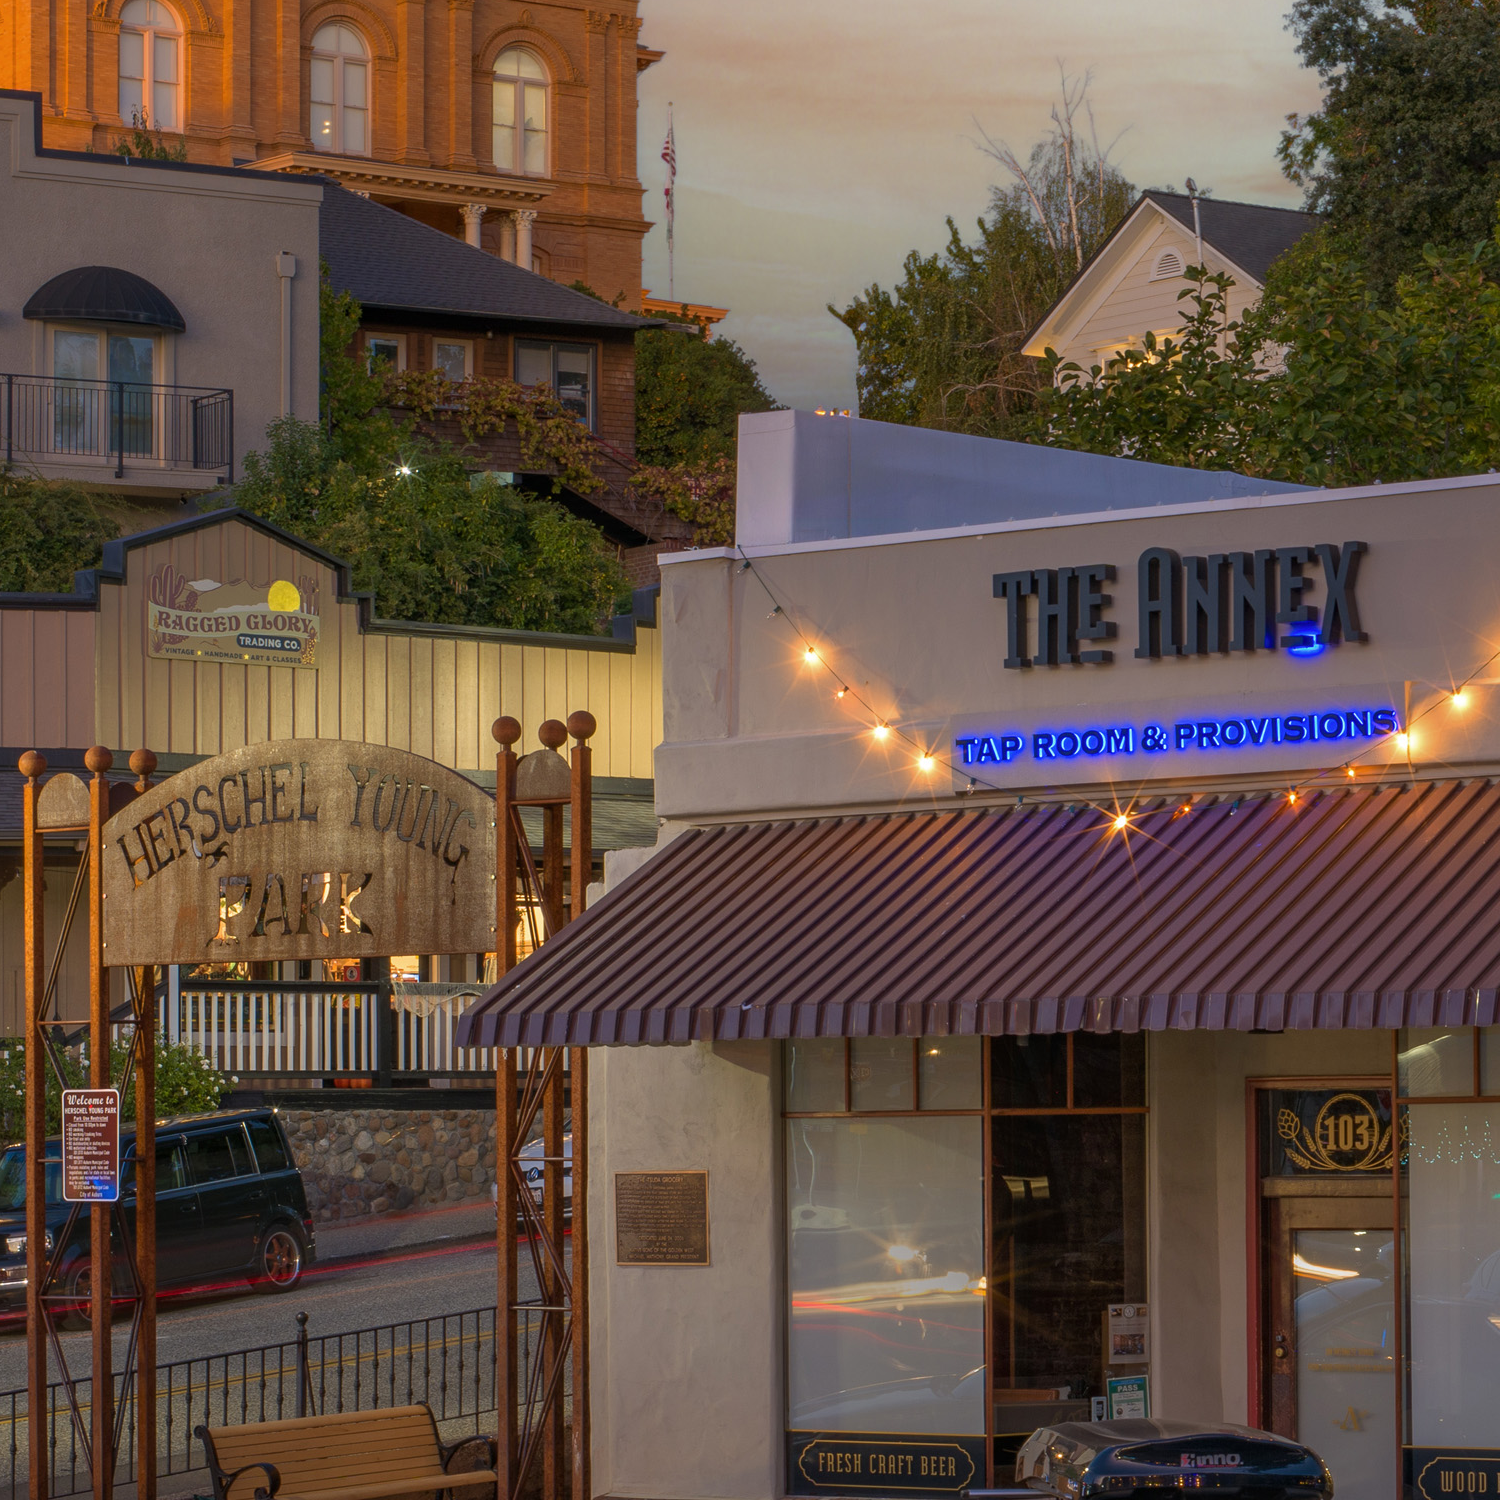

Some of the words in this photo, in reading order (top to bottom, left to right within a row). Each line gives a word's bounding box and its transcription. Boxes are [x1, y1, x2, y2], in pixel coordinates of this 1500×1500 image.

[992, 563, 1117, 670] THE
[1134, 540, 1369, 659] ANNEX
[157, 610, 241, 633] RAGGED
[246, 613, 312, 633] GLORY
[239, 636, 281, 648] TRADING
[284, 640, 300, 650] CO.
[165, 647, 195, 656] VINTAGE
[204, 650, 243, 660] HANDMADE
[250, 653, 265, 661] ART
[272, 656, 302, 664] CLASSES
[956, 733, 1024, 764] TAP
[1034, 723, 1135, 760] ROOM
[1142, 725, 1168, 751] &
[1175, 706, 1398, 749] PROVISIONS
[116, 762, 320, 892] HERSCHEL
[347, 762, 478, 872] YOUNG
[205, 871, 374, 948] PARK
[67, 1094, 104, 1105] Welcome
[106, 1095, 114, 1105] to
[1324, 1114, 1369, 1150] 103
[1117, 1384, 1138, 1393] PASS
[818, 1452, 862, 1473] FRESH
[869, 1454, 914, 1475] CRAFT
[920, 1455, 956, 1476] BEER
[1440, 1470, 1488, 1493] WOOD
